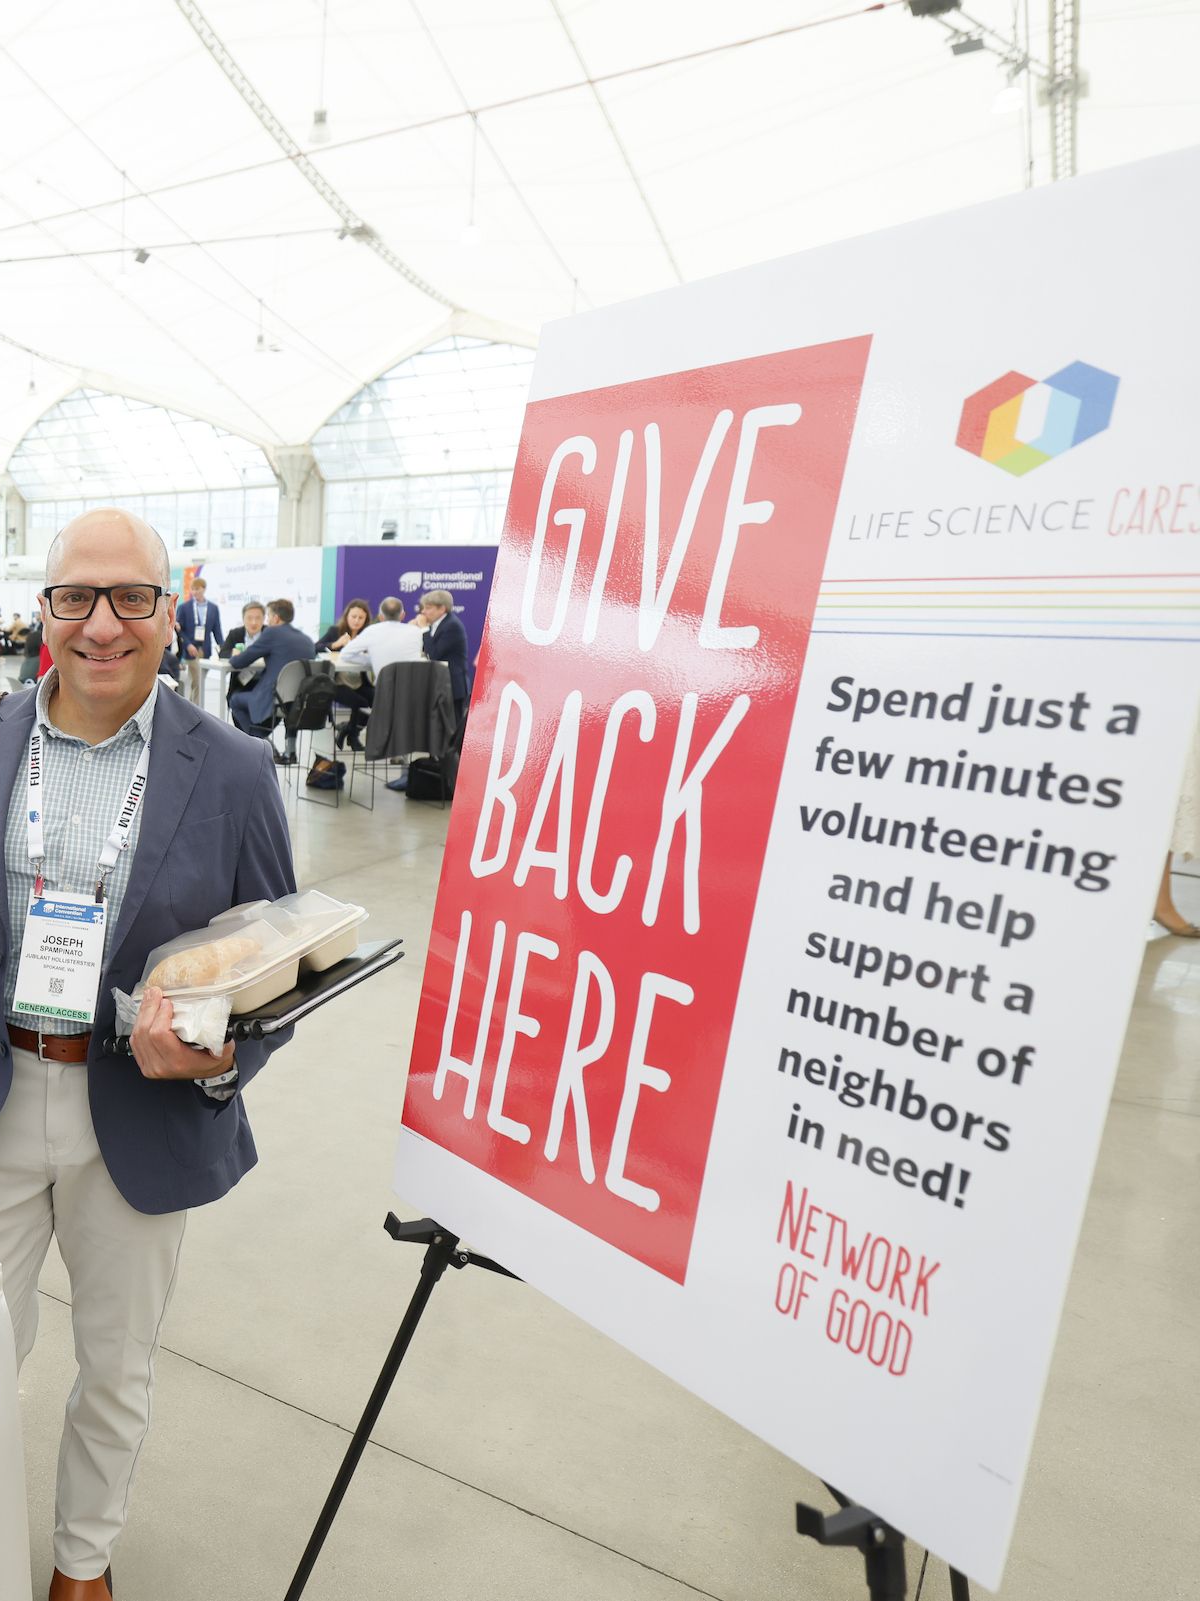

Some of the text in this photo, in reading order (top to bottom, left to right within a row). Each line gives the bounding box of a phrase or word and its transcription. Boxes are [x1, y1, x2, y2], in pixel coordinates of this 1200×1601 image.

[521, 403, 802, 651] GIVE
[848, 511, 913, 540] LIFE
[924, 498, 1095, 538] SCIENCE
[423, 571, 483, 580] International
[423, 581, 476, 590] Convention
[826, 675, 1141, 735] Spend just a
[30, 735, 41, 787] FUJIFILM
[815, 736, 1124, 809] few minutes
[117, 774, 146, 828] FUJIFILM
[469, 680, 751, 934] BACK
[800, 802, 1116, 892] volunteering
[42, 934, 83, 948] JOSEPH
[827, 873, 1036, 947] and help
[25, 953, 51, 961] JUBILANT
[39, 945, 83, 957] SPAMPINATO
[804, 931, 1035, 1015] support a
[18, 1002, 88, 1020] GENERAL ACCESS
[786, 987, 1036, 1086] number of
[433, 910, 695, 1213] HERE
[777, 1046, 1012, 1152] neighbors
[787, 1103, 972, 1209] in need!
[775, 1262, 913, 1377] OF GOOD
